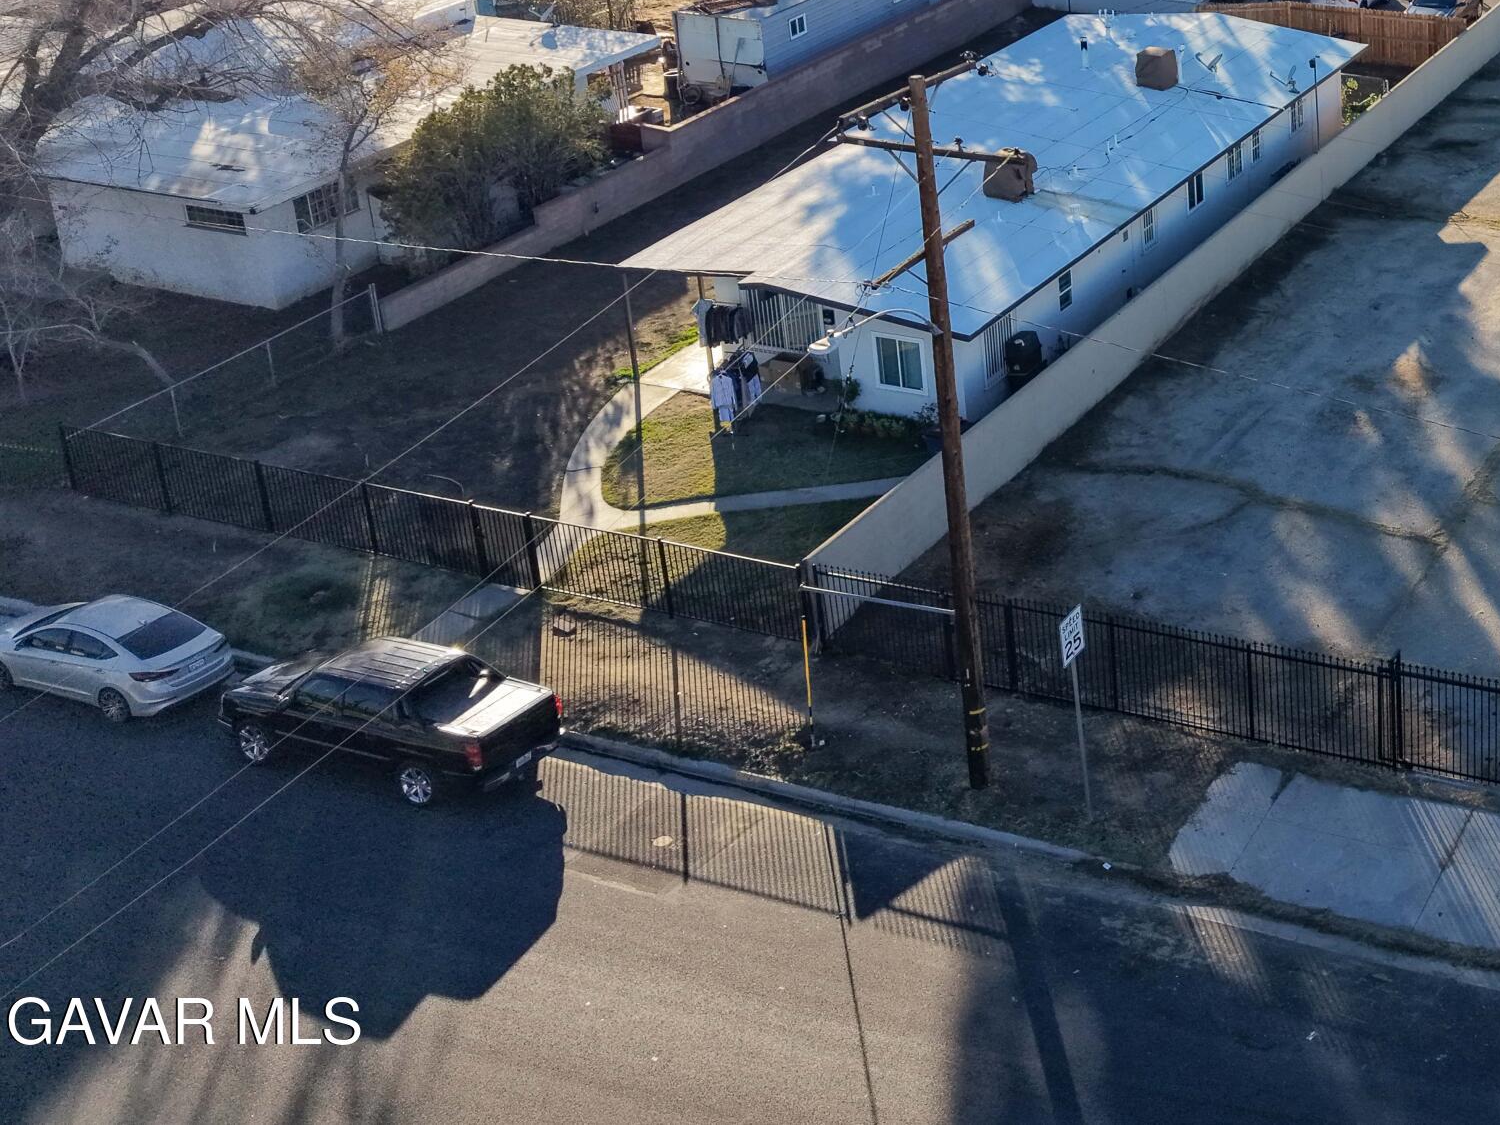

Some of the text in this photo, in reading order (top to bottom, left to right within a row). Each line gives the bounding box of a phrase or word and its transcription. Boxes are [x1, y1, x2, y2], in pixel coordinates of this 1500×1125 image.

[1062, 612, 1080, 634] SPEED
[1064, 622, 1078, 641] LIMIT
[1064, 631, 1082, 660] 25
